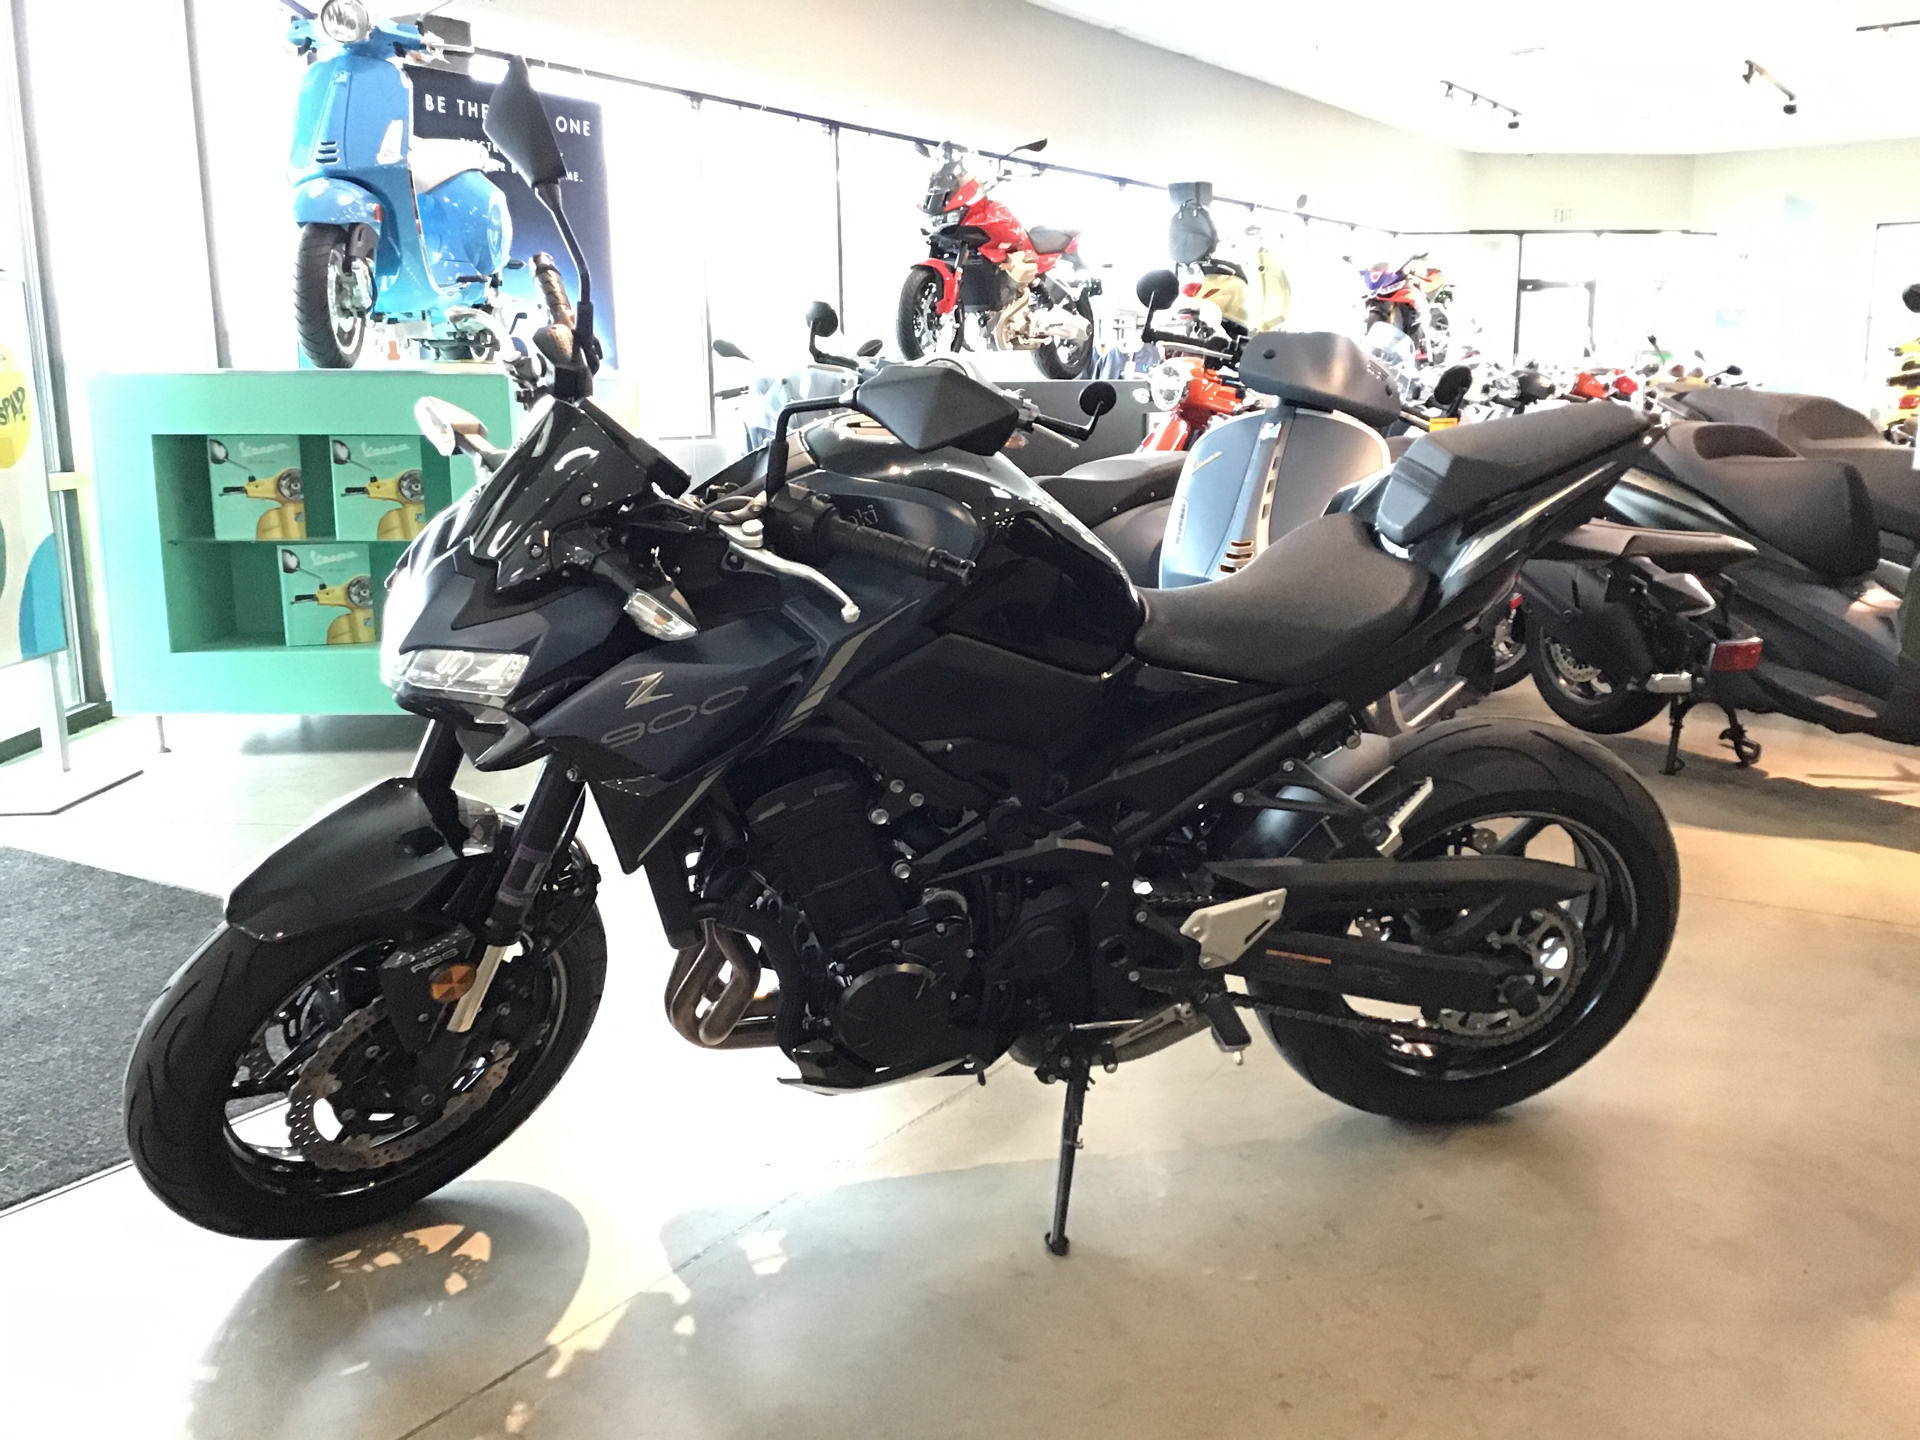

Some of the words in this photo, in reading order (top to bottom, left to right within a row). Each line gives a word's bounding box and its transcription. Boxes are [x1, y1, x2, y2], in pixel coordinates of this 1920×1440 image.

[424, 93, 447, 114] BE
[456, 98, 490, 120] THE
[555, 115, 591, 137] ONE
[1554, 208, 1573, 223] EXIT
[621, 670, 674, 710] Z
[600, 685, 749, 749] 900
[410, 947, 459, 974] ABS
